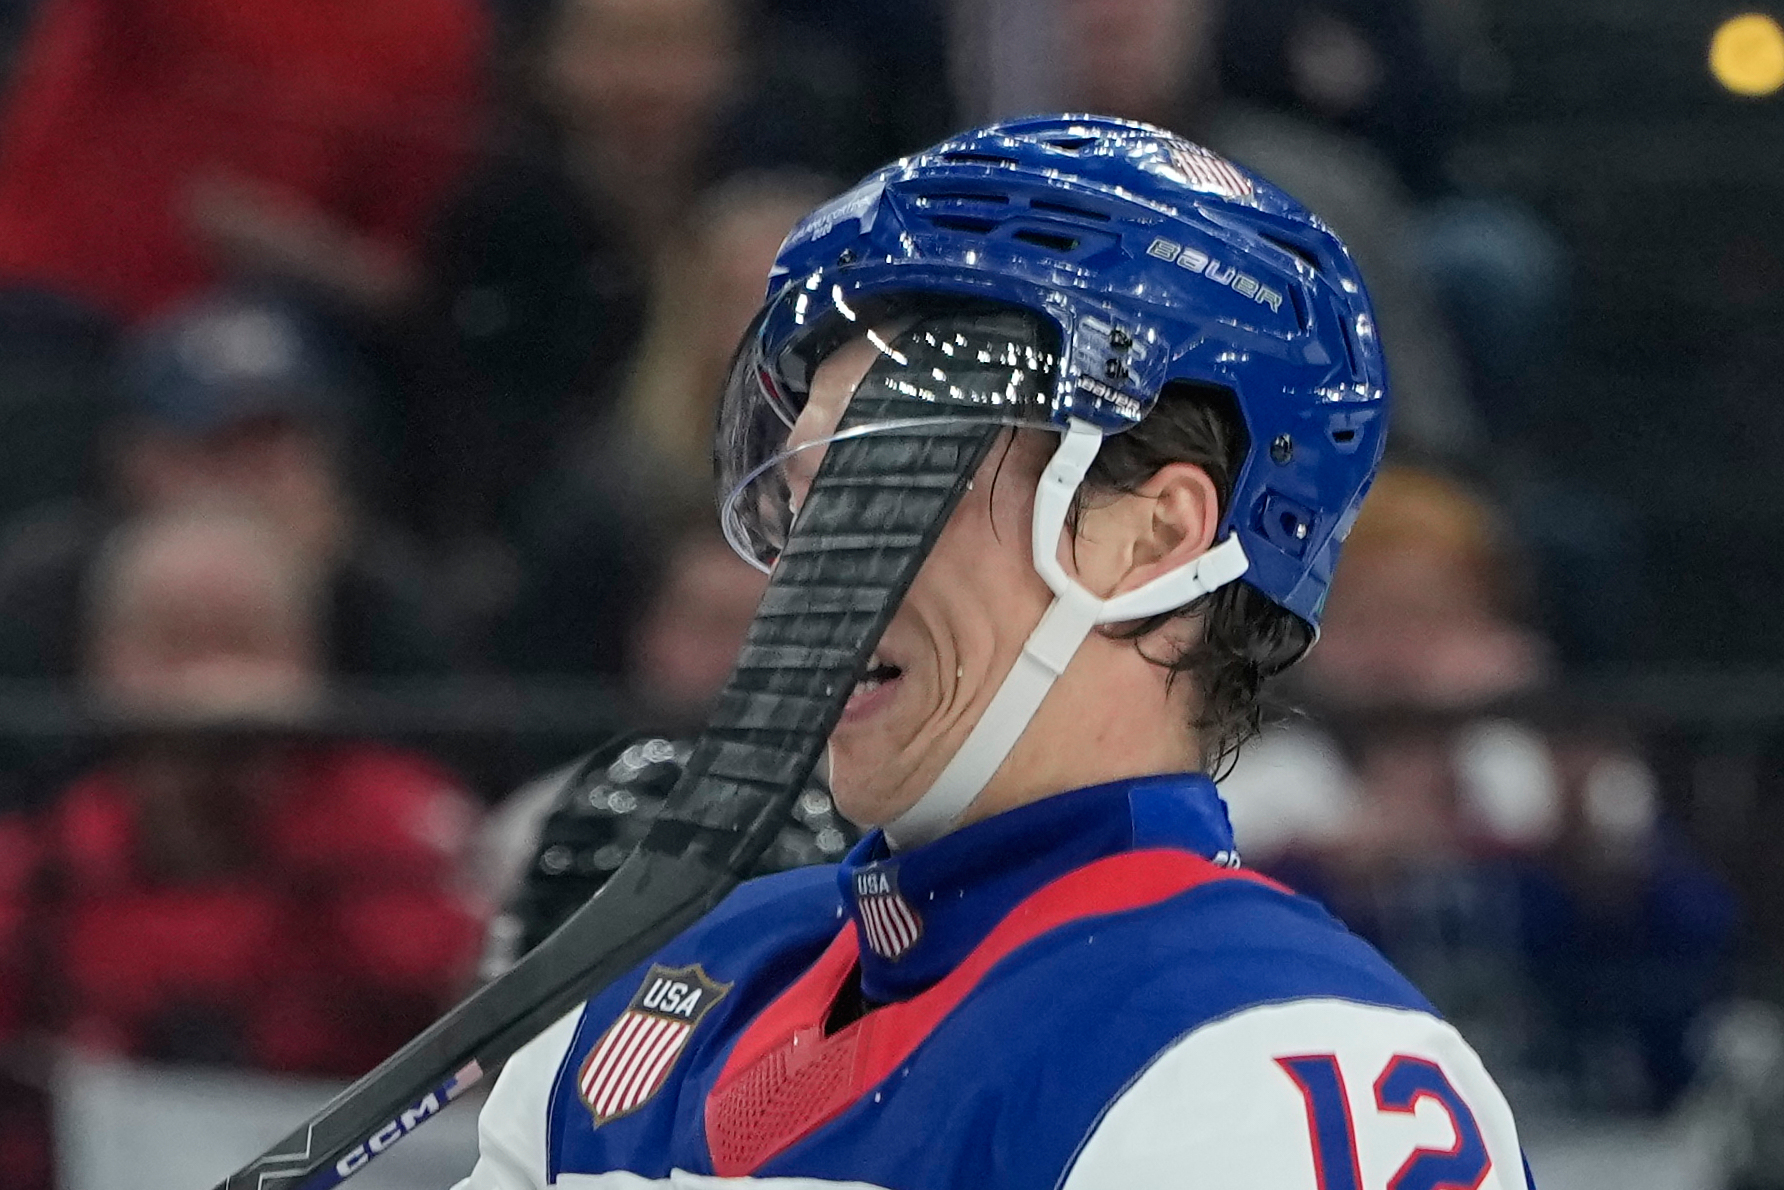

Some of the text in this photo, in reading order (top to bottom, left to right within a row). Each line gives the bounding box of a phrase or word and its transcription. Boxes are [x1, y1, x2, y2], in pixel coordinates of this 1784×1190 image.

[1146, 236, 1282, 314] BAUER
[857, 872, 890, 895] USA
[643, 978, 702, 1018] USA
[336, 1092, 441, 1180] CCM
